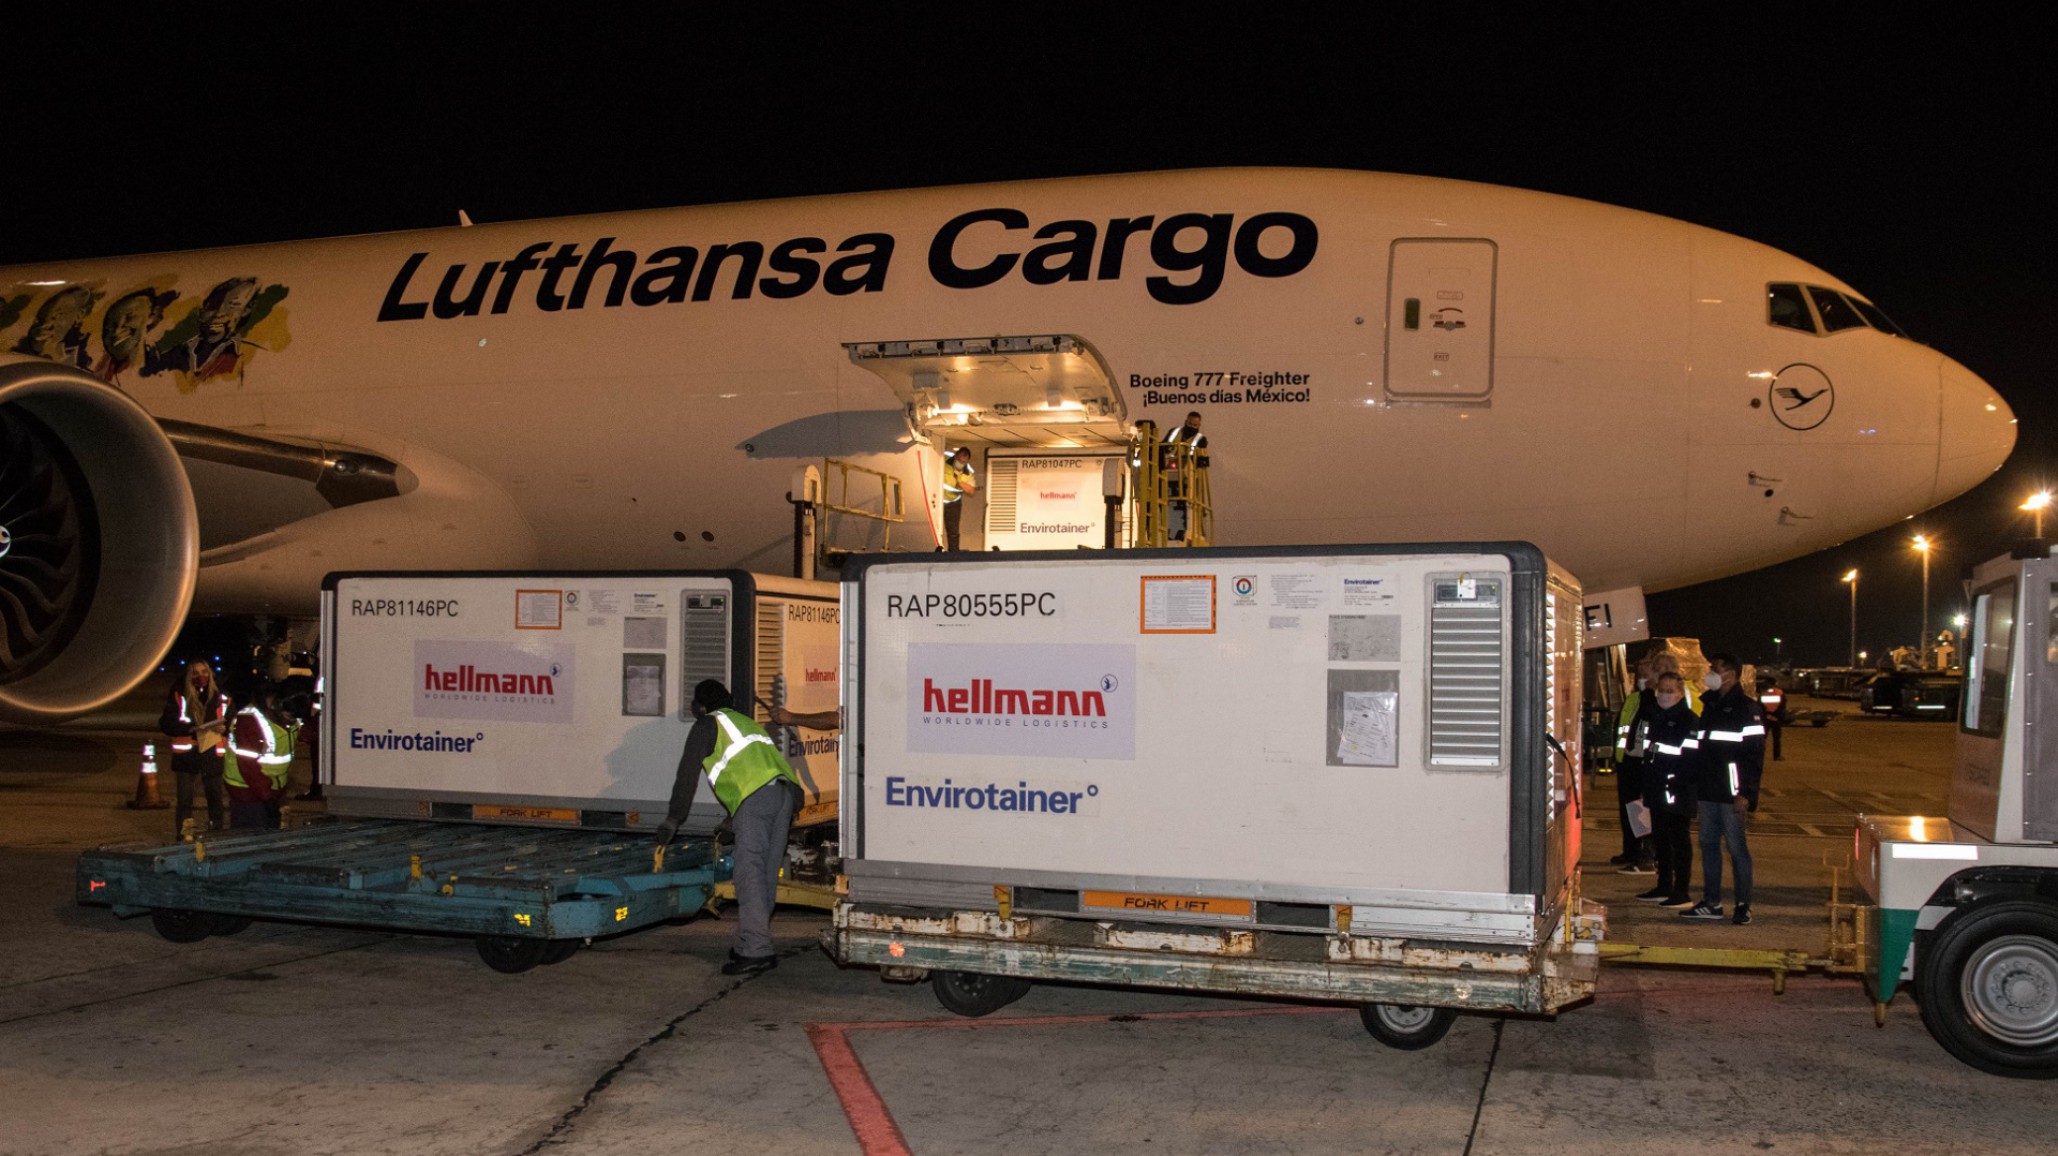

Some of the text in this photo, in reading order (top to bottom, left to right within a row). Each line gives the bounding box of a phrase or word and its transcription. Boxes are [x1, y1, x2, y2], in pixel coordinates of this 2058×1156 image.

[377, 207, 1319, 322] Lufthansa Cargo
[1130, 371, 1310, 389] Boeing 777 Freighter
[1143, 387, 1310, 407] ¡Buenos días México!
[1021, 459, 1083, 469] RAP81047PC
[1039, 491, 1076, 499] hellmann
[351, 599, 459, 618] RAP81146PC
[887, 592, 1056, 618] RAP80555PC
[425, 663, 554, 696] hellmann
[805, 668, 835, 682] hellmann
[425, 693, 555, 705] WORLDWIDE LOGISTICS
[923, 677, 1106, 717] hellmann
[923, 716, 1108, 729] WORLDWIDE LOGISTICS
[788, 732, 839, 757] Envirotain
[500, 808, 553, 818] FORK LIFT
[1124, 897, 1210, 912] FORK LIFT
